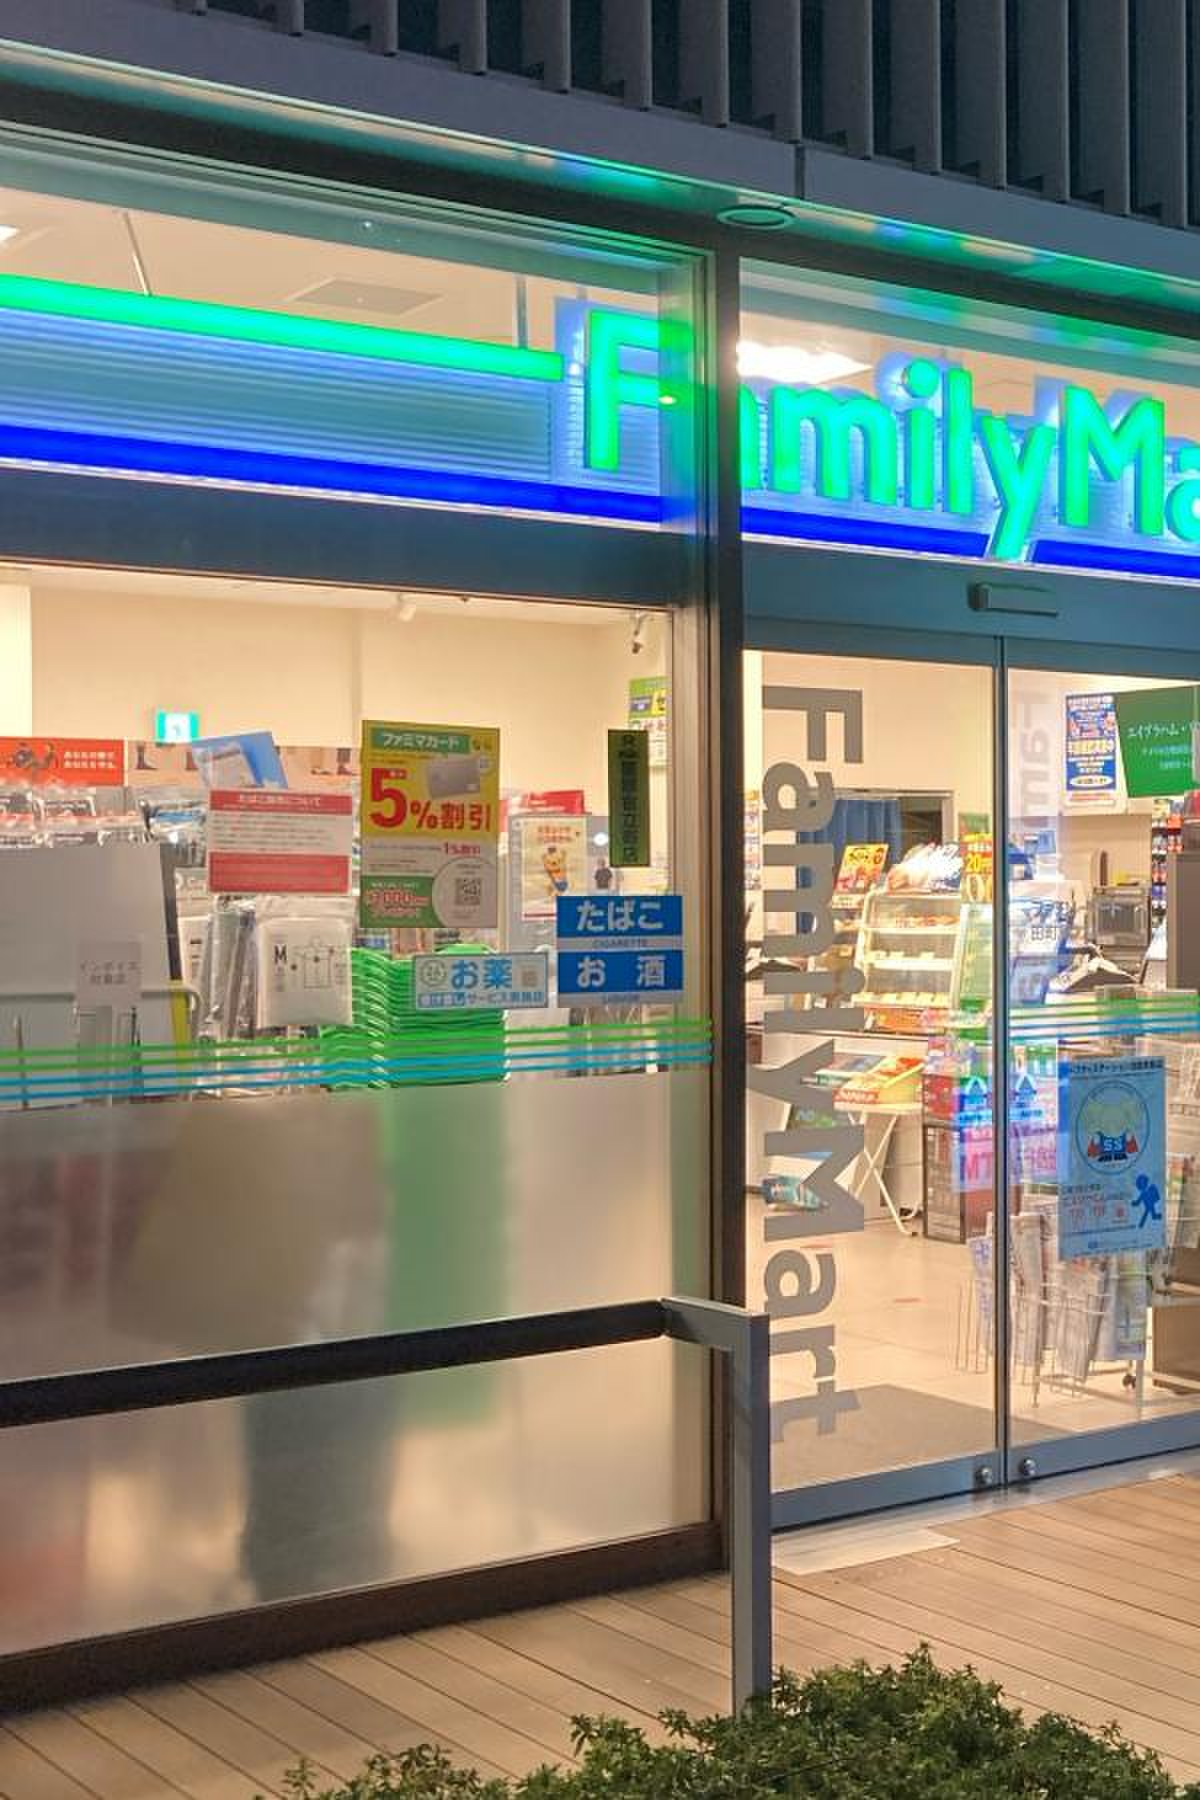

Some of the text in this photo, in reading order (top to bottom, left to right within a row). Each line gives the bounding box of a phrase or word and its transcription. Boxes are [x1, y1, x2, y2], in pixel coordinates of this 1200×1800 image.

[577, 900, 663, 932] たばこ
[451, 959, 513, 989] お薬
[745, 686, 866, 1442] FamilyMart
